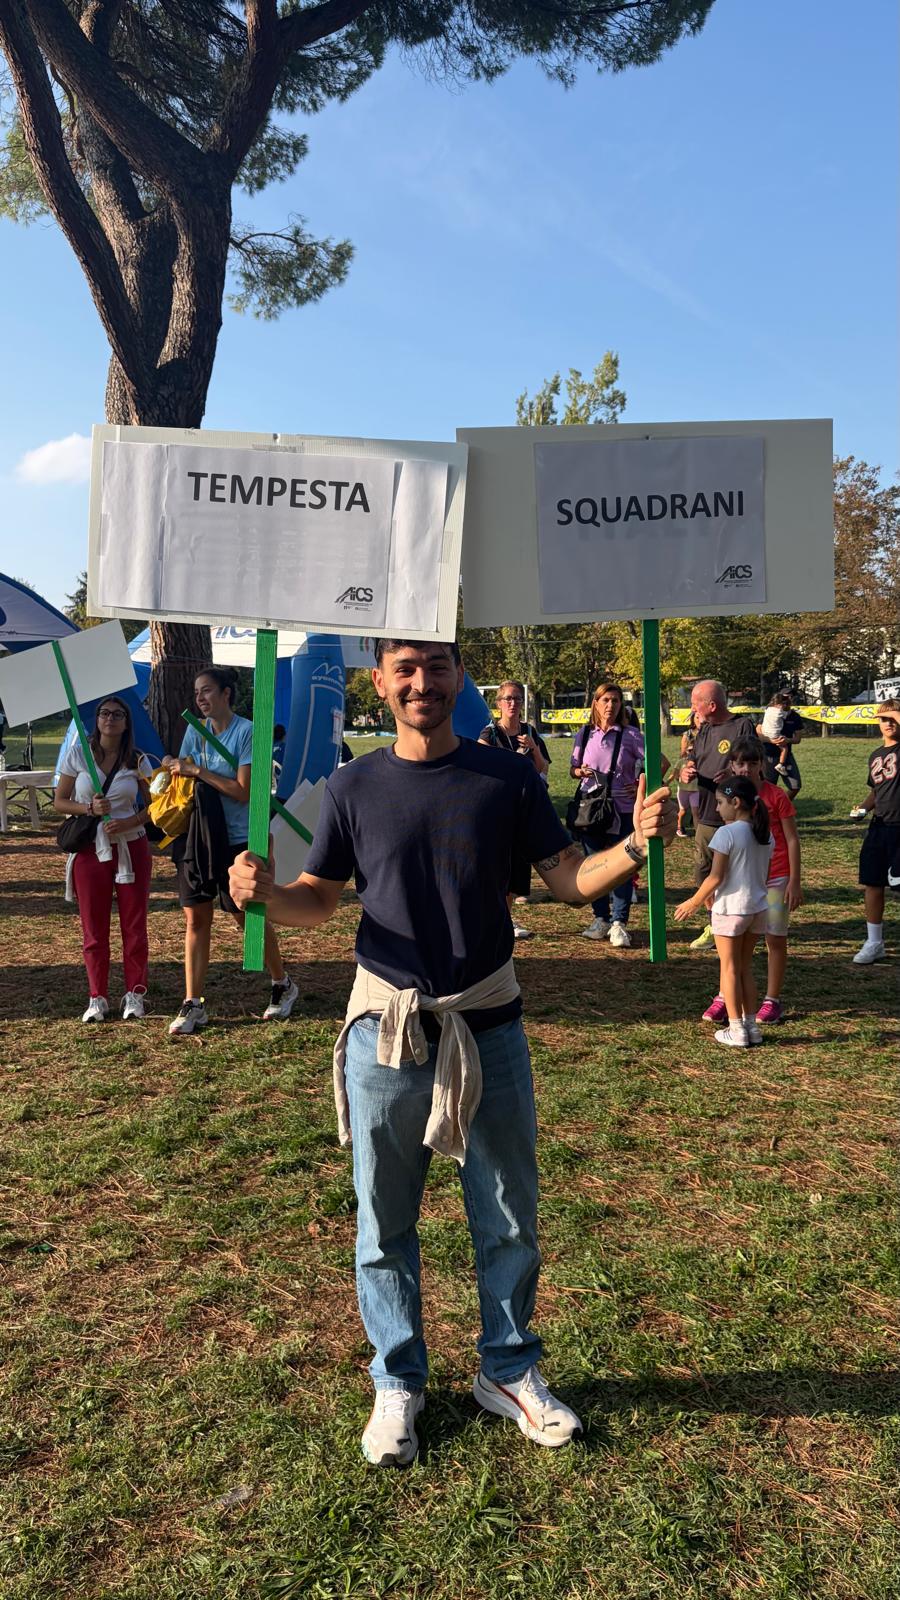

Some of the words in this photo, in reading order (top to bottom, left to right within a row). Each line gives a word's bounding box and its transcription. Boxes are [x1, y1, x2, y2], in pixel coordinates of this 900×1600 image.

[187, 471, 371, 513] TEMPESTA
[556, 490, 744, 528] SQUADRANI
[870, 752, 898, 785] 23
